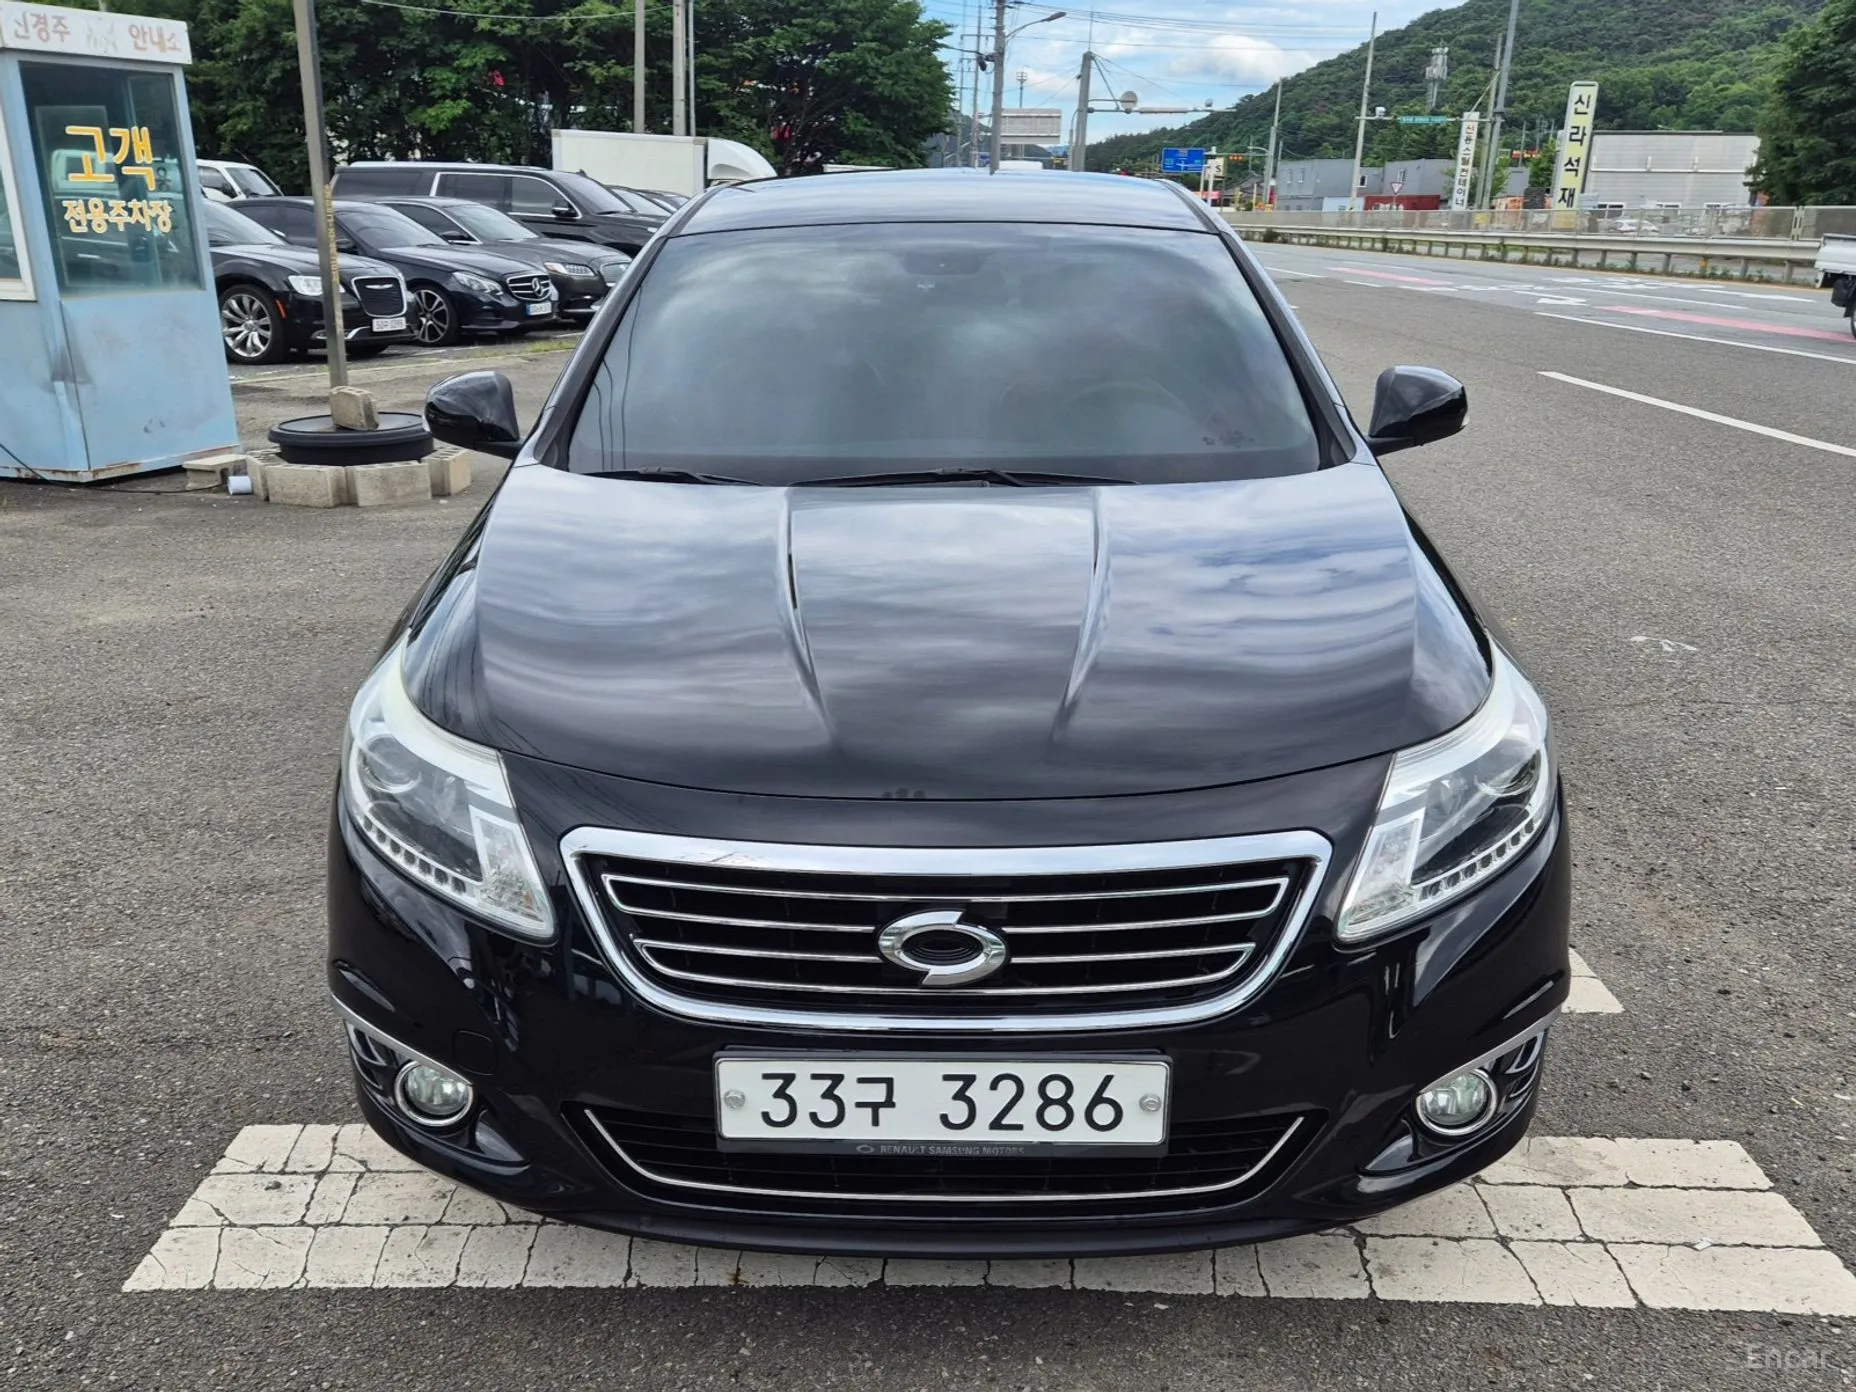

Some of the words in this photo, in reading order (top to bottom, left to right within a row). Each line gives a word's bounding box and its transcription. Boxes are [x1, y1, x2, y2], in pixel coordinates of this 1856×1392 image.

[13, 11, 71, 44] 신경주
[128, 23, 182, 52] 안내소
[65, 125, 157, 191] 고객
[1557, 93, 1591, 209] 신라석재
[61, 197, 174, 234] 전용주차장
[760, 1072, 897, 1129] 33구
[938, 1073, 1124, 1133] 3286
[880, 1144, 925, 1155] RENAULT
[928, 1145, 980, 1156] SAMSUNG
[982, 1146, 1025, 1156] MOTORS
